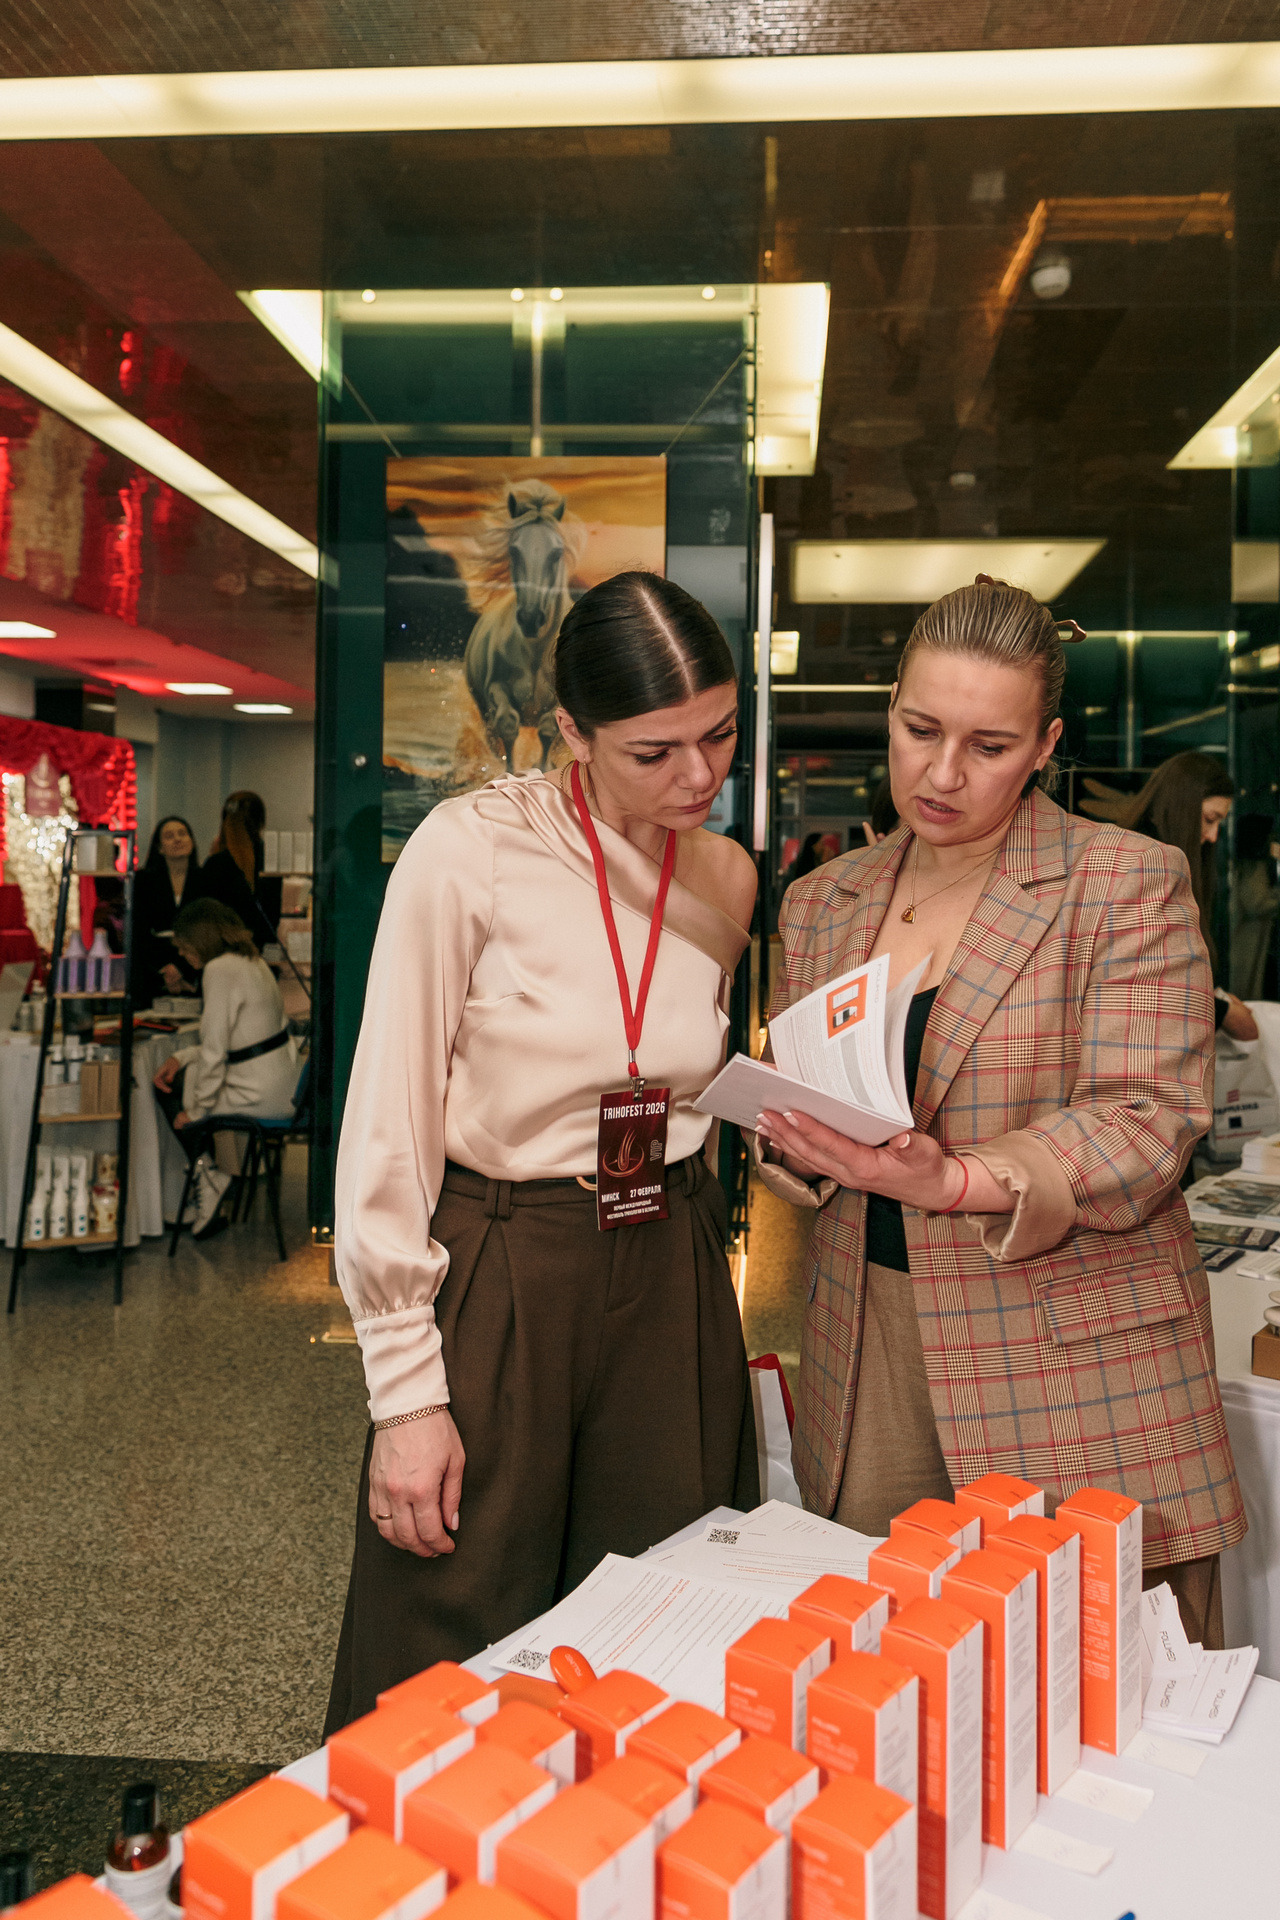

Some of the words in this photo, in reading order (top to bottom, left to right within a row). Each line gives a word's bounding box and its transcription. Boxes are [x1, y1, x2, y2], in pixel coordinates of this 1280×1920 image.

[603, 1104, 644, 1120] TRIHOFEST
[645, 1102, 666, 1115] 2026
[601, 1192, 620, 1203] МИНСК
[630, 1189, 637, 1198] 27
[637, 1185, 662, 1196] ФЕВРАЛЯ
